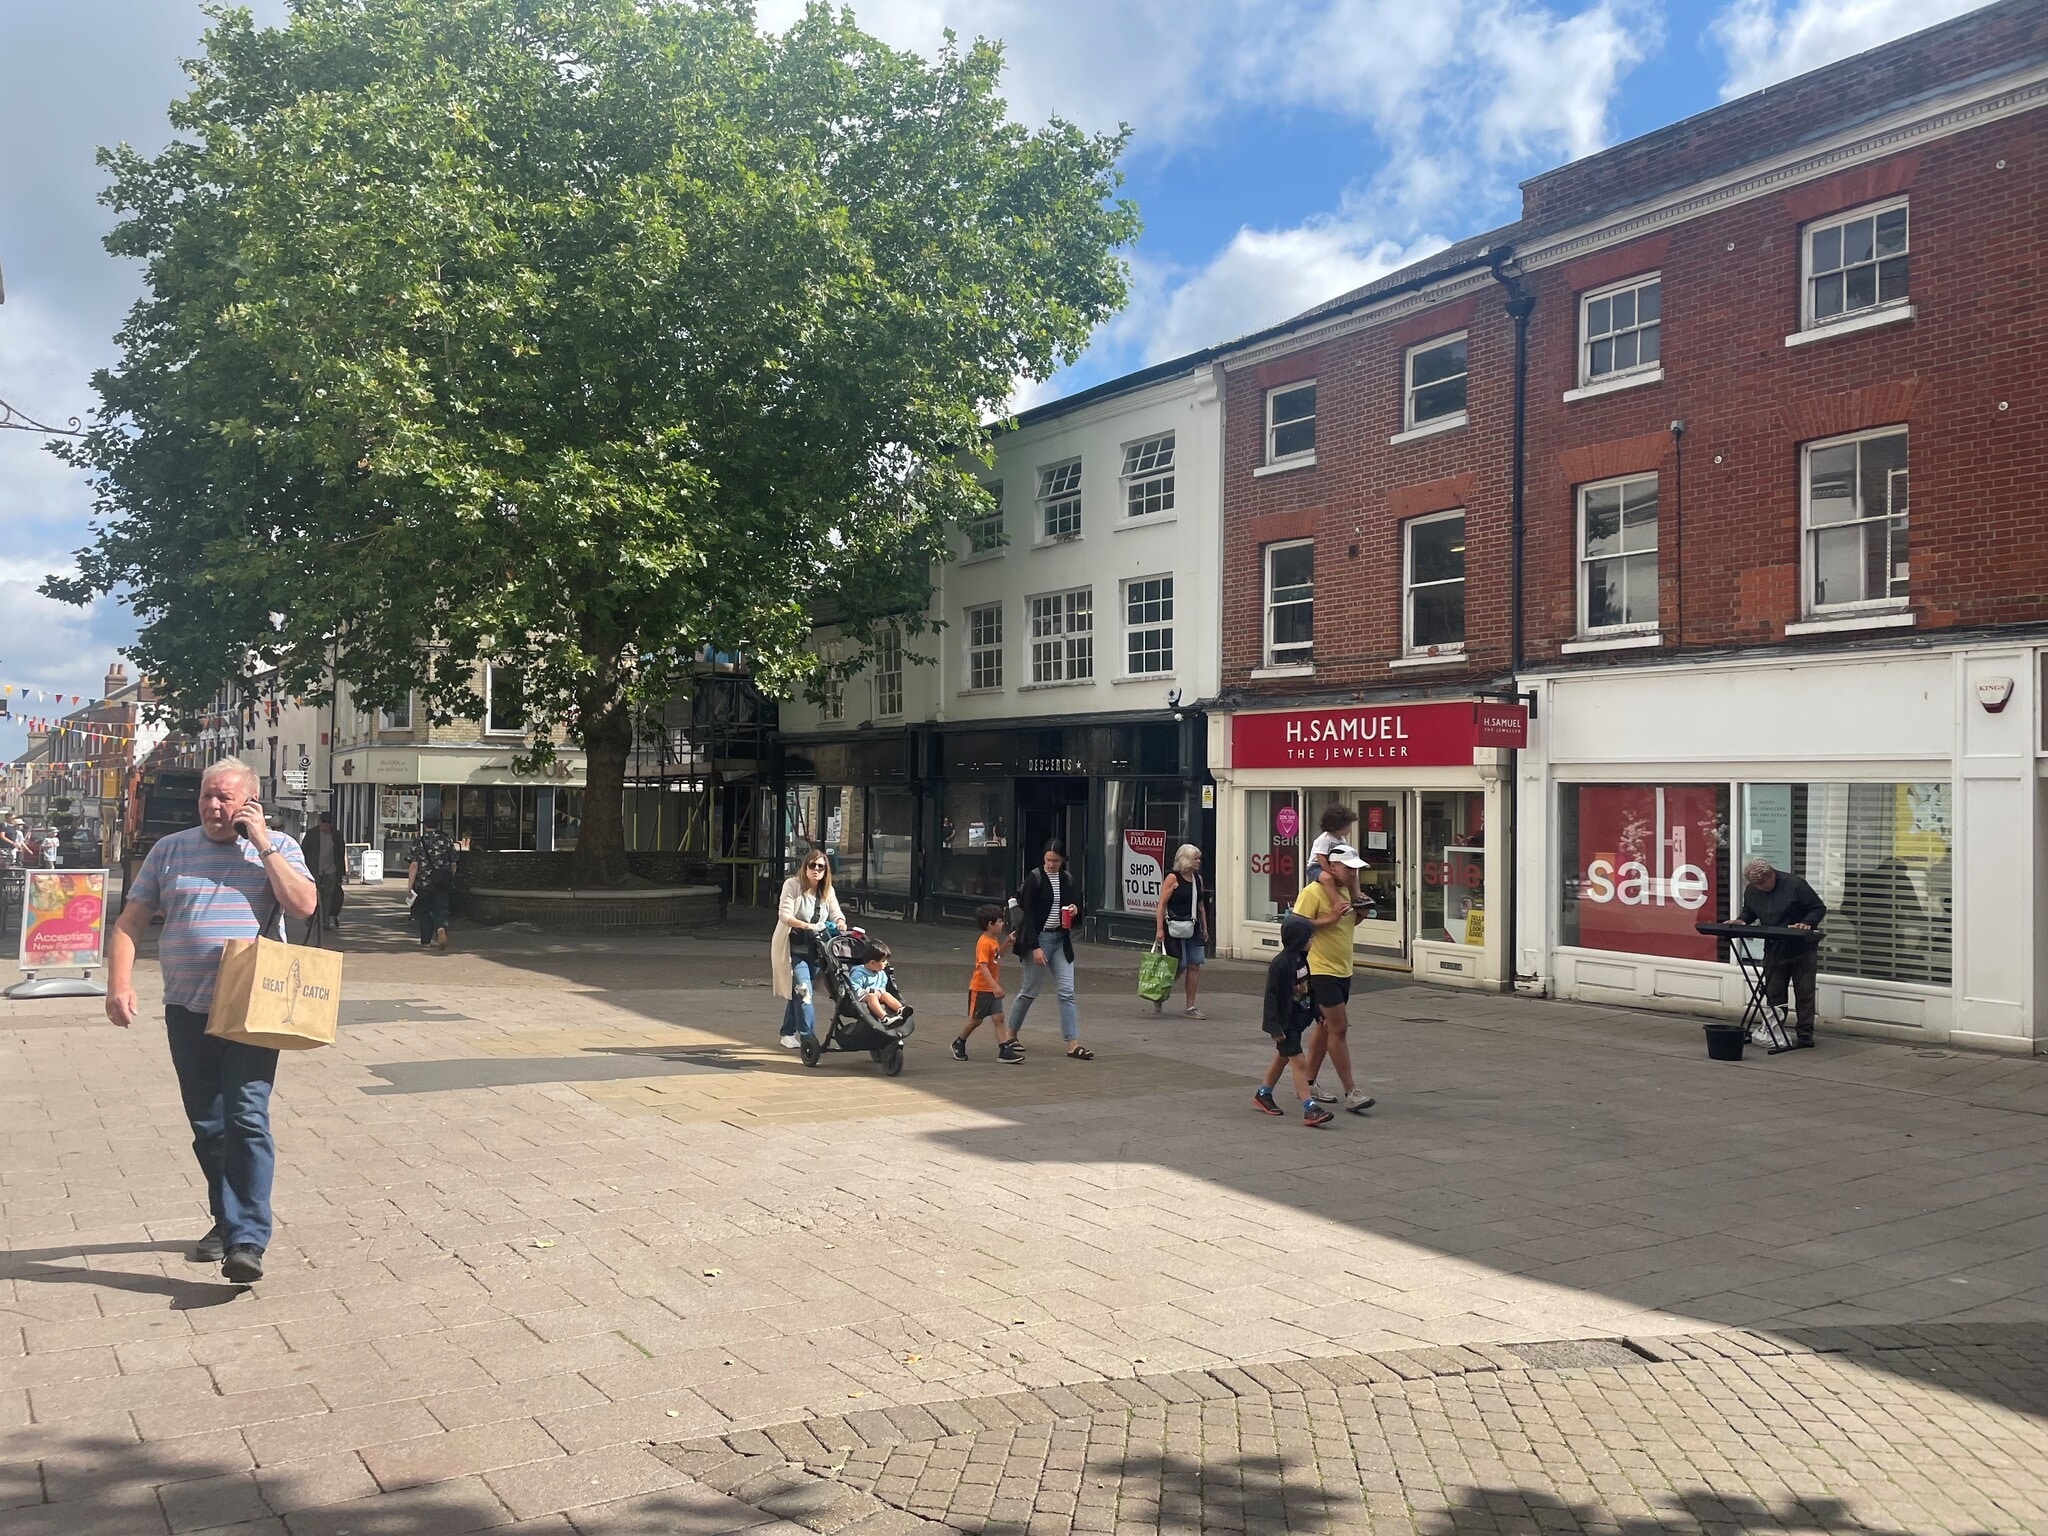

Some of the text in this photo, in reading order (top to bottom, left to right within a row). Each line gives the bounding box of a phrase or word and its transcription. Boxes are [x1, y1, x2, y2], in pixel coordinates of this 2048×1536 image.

[1286, 716, 1409, 743] H.SAMUEL
[1483, 718, 1522, 728] H.SAMUEL
[1287, 746, 1409, 761] THE JEWELLER
[1130, 836, 1164, 847] DARRAH
[1251, 845, 1294, 876] sale
[1130, 863, 1155, 877] SHOP
[1425, 853, 1481, 889] sale
[1125, 879, 1161, 896] TO LET
[34, 931, 94, 943] Accepting
[33, 942, 54, 951] New
[262, 977, 330, 1001] GREAT CATCH
